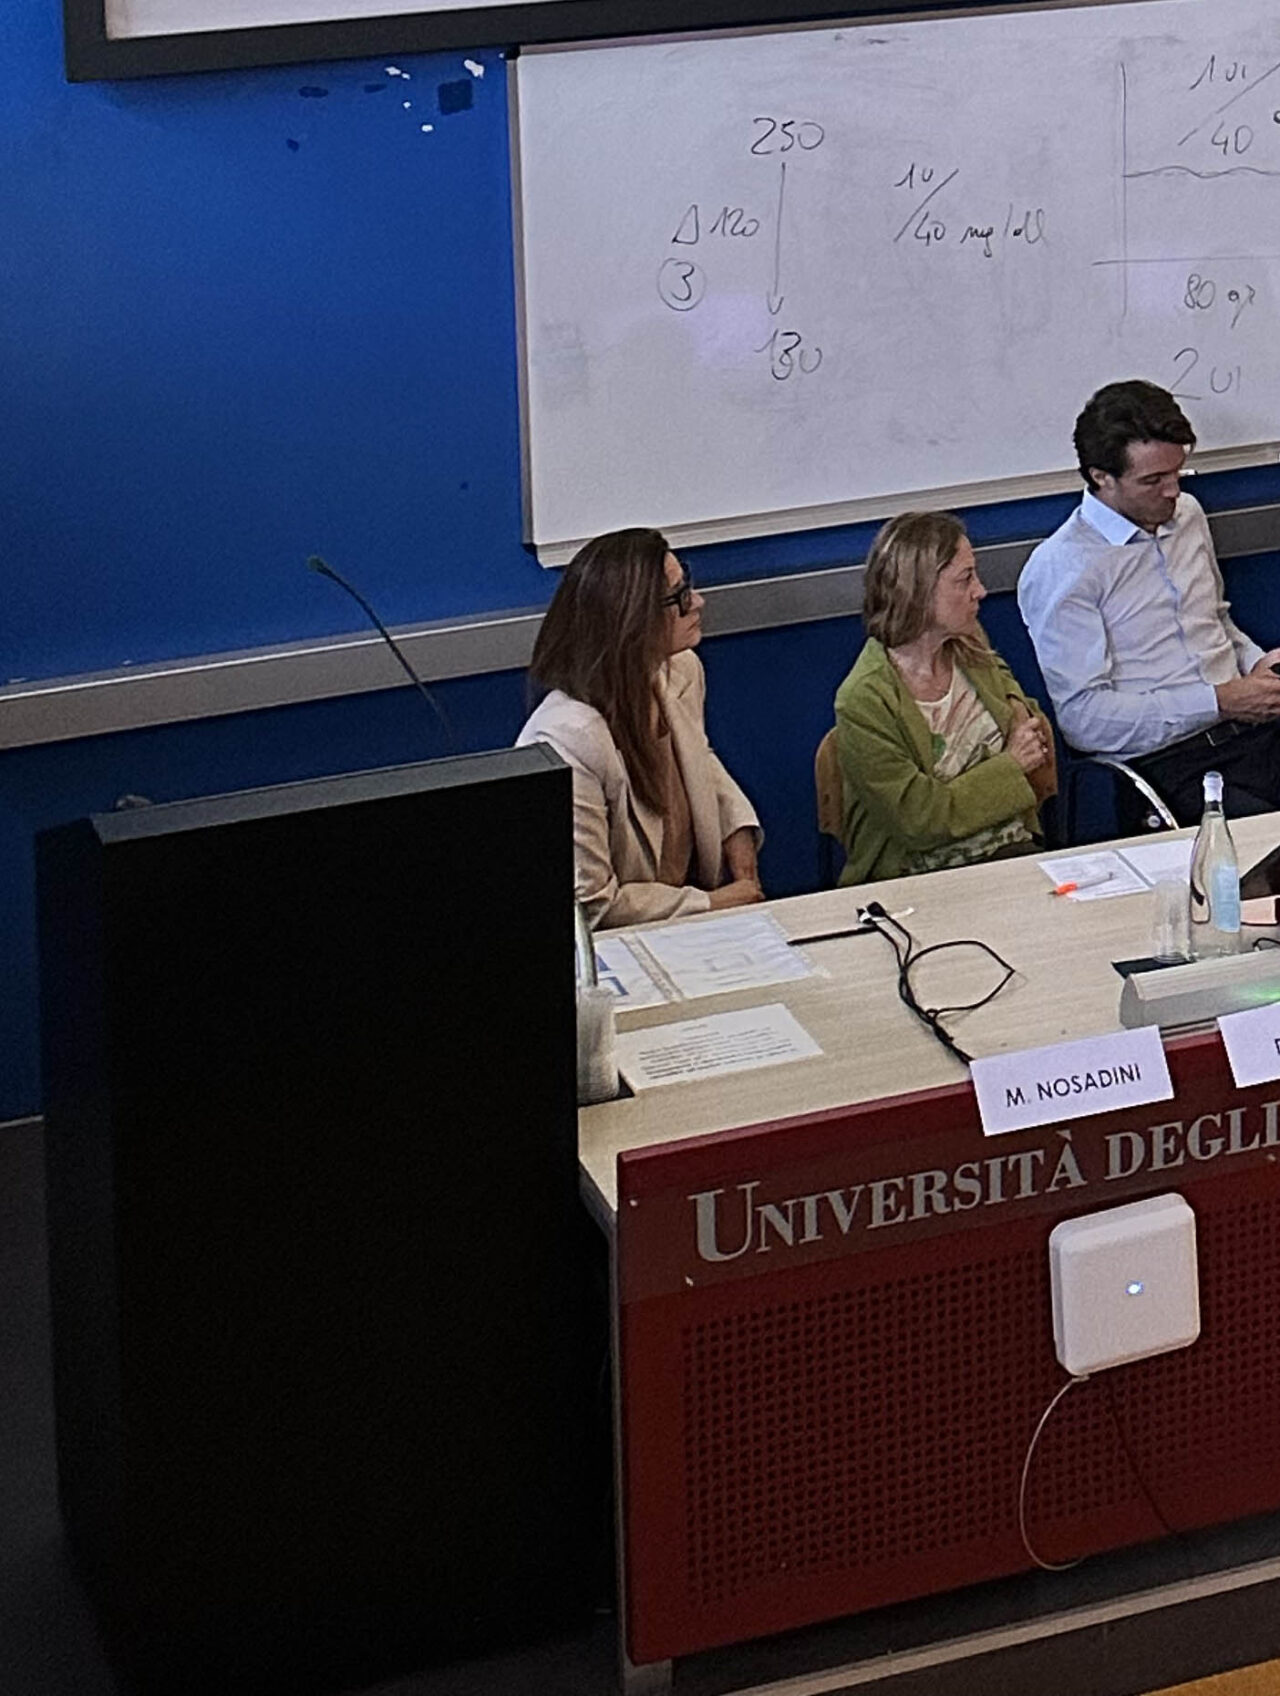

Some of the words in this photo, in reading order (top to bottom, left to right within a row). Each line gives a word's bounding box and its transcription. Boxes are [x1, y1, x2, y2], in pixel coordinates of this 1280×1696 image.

[751, 117, 824, 154] 250
[671, 261, 694, 301] 3
[1036, 1063, 1143, 1101] NOSADINI
[688, 1130, 1087, 1263] UNIVERSITÀ
